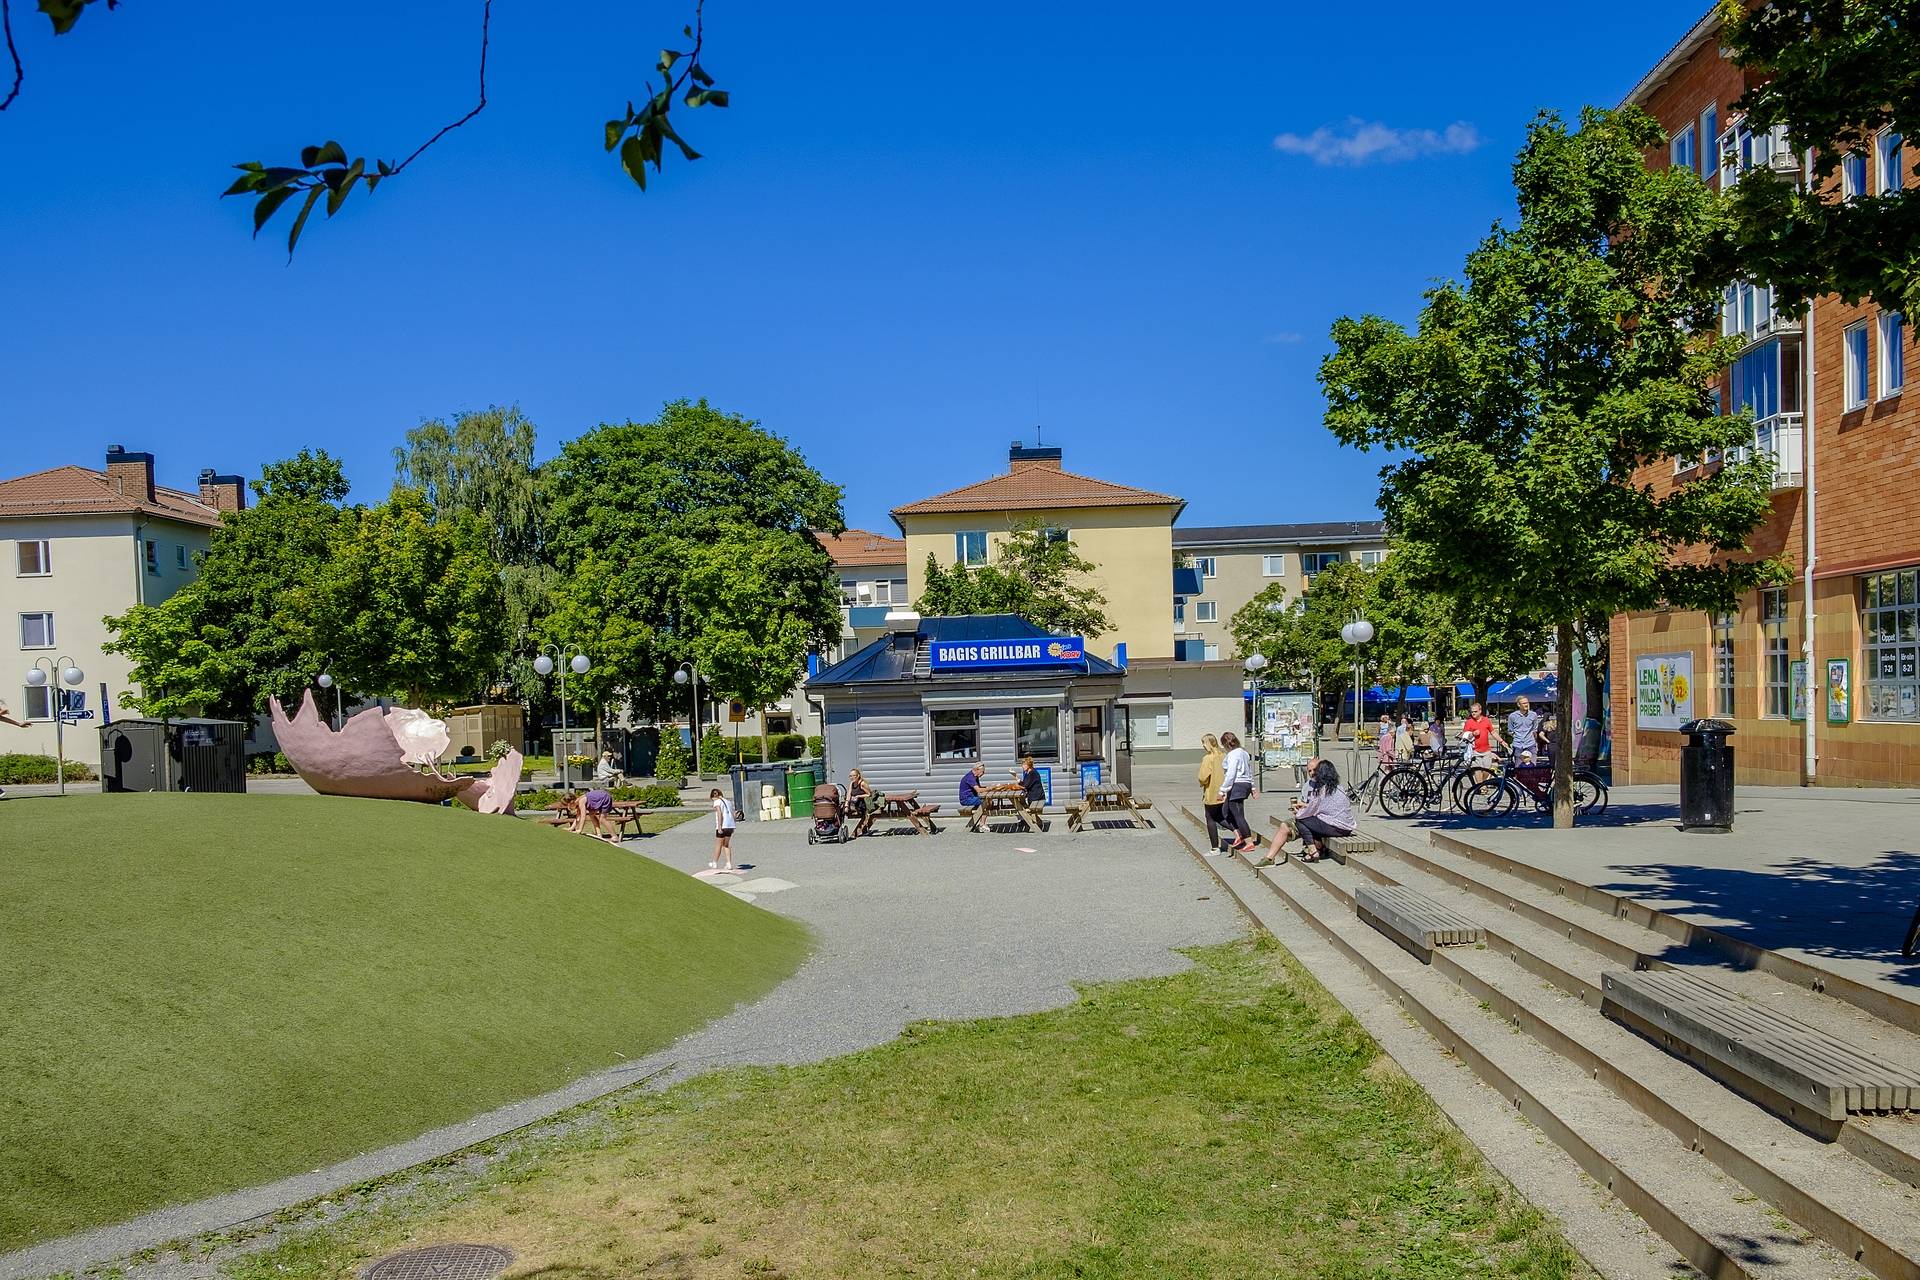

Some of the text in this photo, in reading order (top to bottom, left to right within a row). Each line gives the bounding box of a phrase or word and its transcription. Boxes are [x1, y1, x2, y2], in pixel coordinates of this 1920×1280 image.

[939, 645, 1041, 661] BAGIS GRILLBAR
[1639, 688, 1662, 703] MILDA
[1640, 704, 1663, 717] PRISER.
